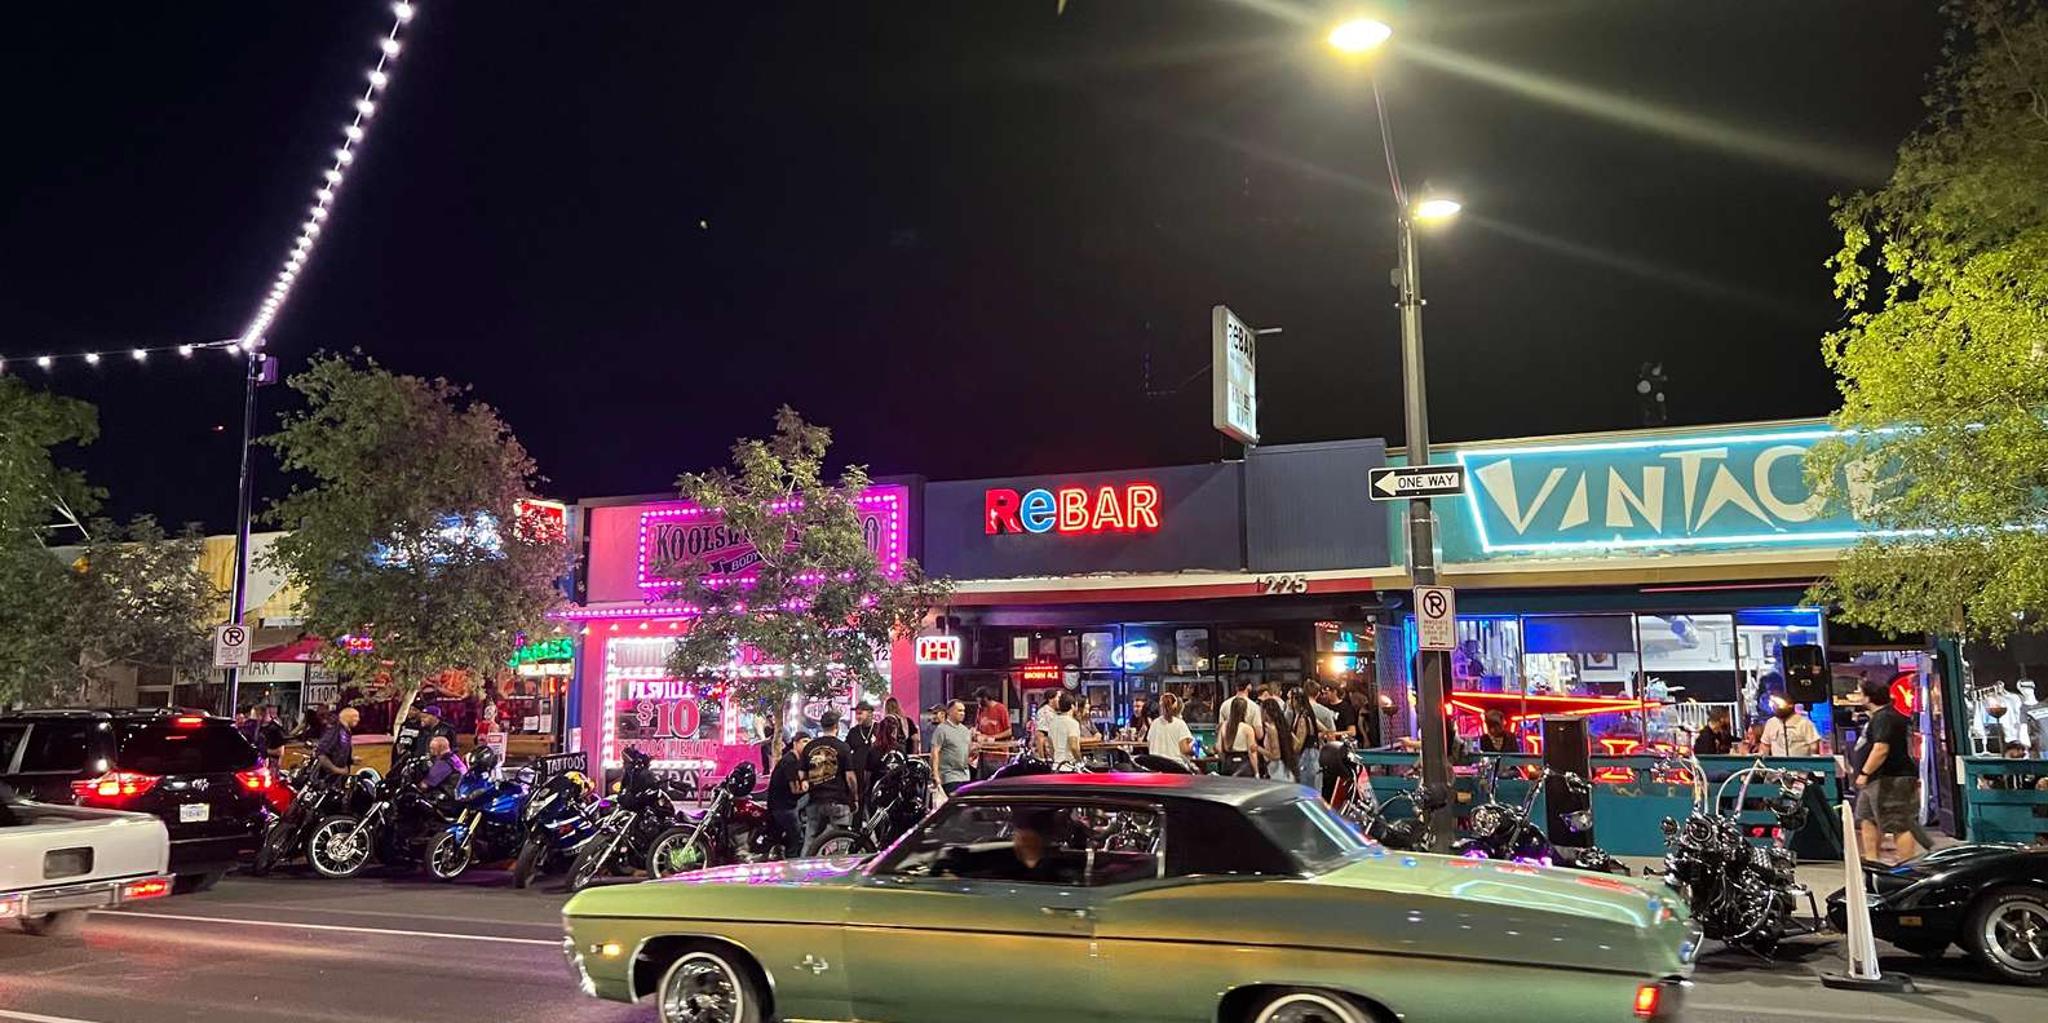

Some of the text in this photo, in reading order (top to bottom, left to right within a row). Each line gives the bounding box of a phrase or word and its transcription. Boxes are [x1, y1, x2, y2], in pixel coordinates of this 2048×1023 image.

[1398, 474, 1454, 488] ONE WAY
[1475, 446, 1875, 536] VINTAG
[986, 485, 1159, 534] ReBAR
[731, 552, 757, 571] BODY
[1256, 574, 1307, 594] 1225
[919, 639, 959, 661] OPEN
[636, 699, 700, 738] $10
[545, 754, 586, 774] TATTOOS
